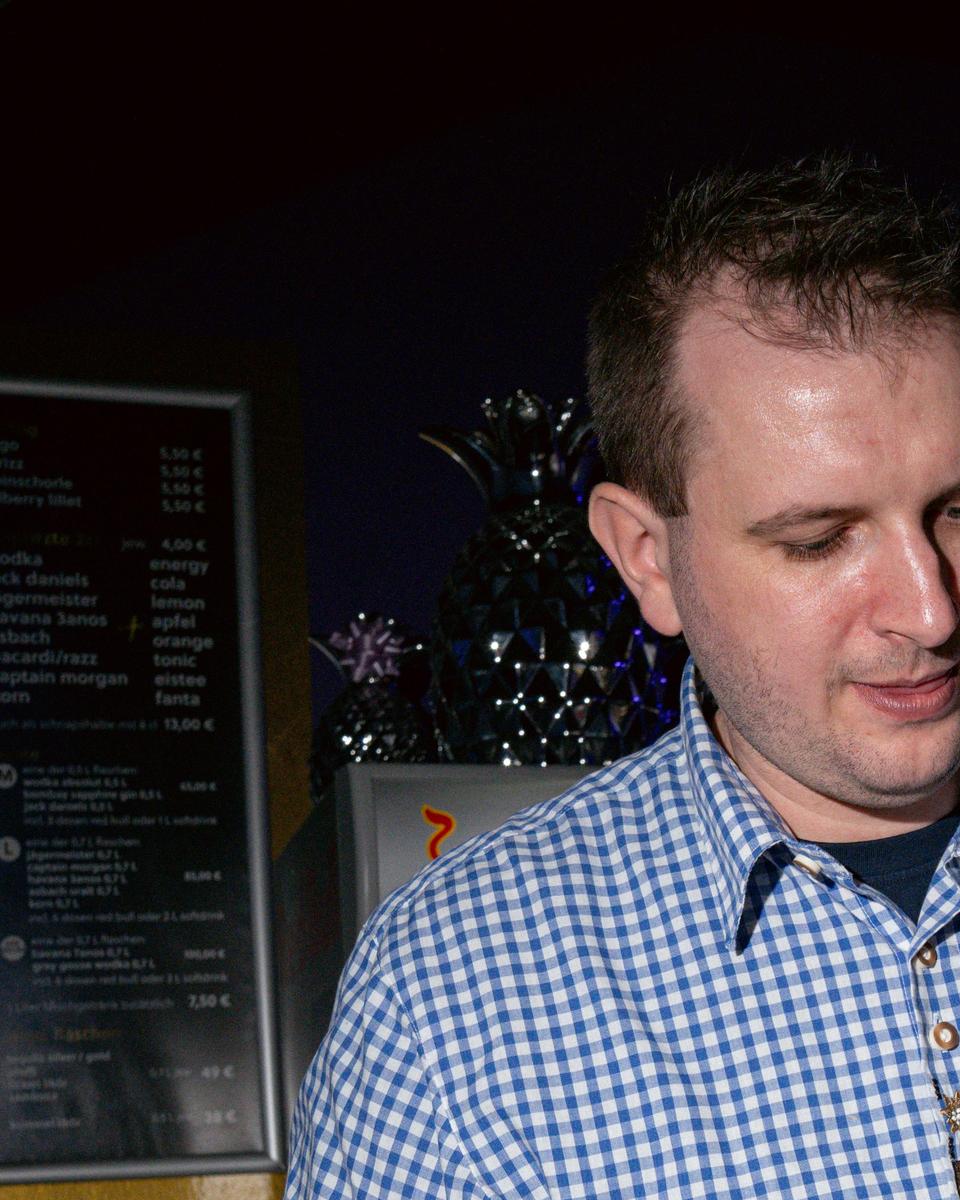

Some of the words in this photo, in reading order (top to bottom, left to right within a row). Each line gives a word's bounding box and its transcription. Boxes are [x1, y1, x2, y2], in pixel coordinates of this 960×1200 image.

[150, 559, 210, 576] energy
[25, 570, 90, 588] daniels
[150, 576, 186, 591] cola
[0, 591, 98, 609] germeister
[151, 593, 206, 611] lemon
[152, 612, 196, 632] apfel
[152, 636, 215, 653] orange
[153, 653, 198, 668] tonic
[60, 672, 129, 690] morgan
[154, 672, 207, 687] eistee
[155, 689, 201, 707] fanta
